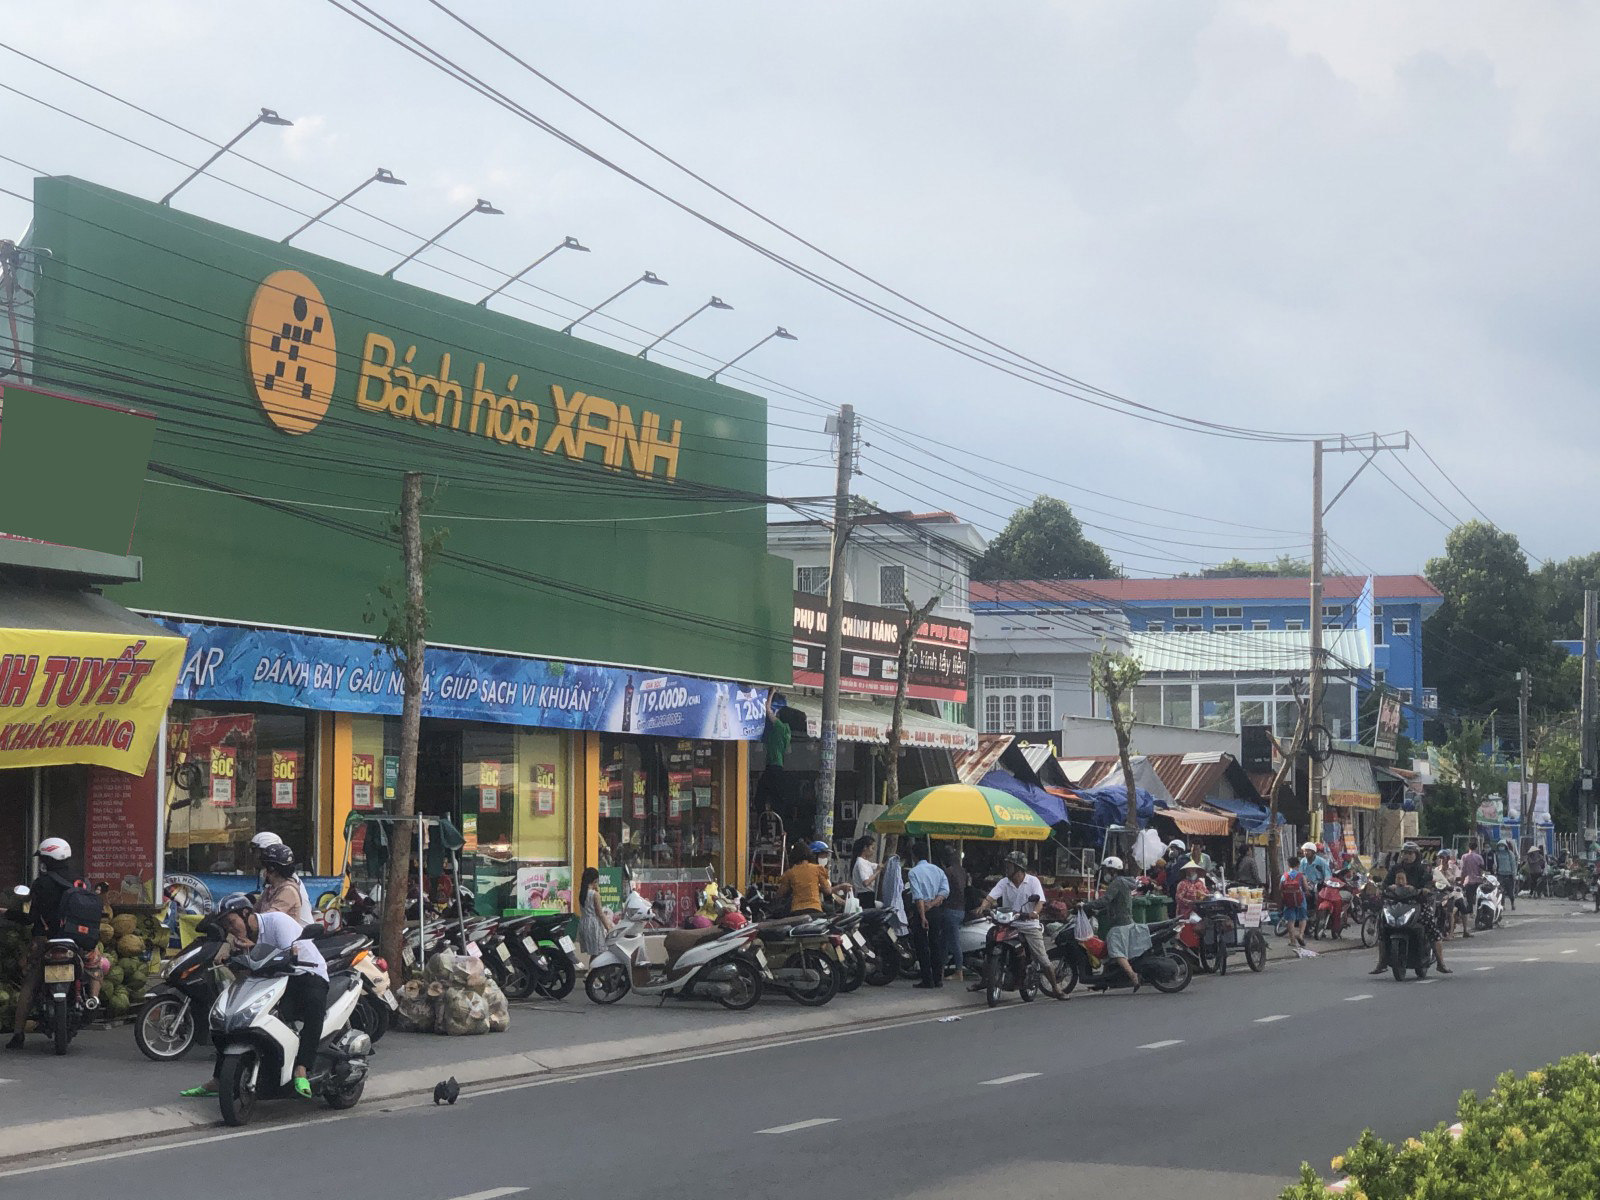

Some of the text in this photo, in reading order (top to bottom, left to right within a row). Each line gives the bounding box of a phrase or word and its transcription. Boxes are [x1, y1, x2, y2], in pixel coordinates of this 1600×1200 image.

[357, 331, 684, 484] Bách hóa XANH
[793, 607, 815, 635] PHỤ
[36, 639, 156, 709] TUYẾT
[253, 651, 310, 688] ĐÁNH
[313, 662, 347, 691] BAY
[349, 663, 387, 694] GÀU
[440, 673, 478, 700] GIÚP
[480, 679, 518, 707] SẠCH
[522, 683, 537, 707] VI
[919, 650, 938, 671] kính
